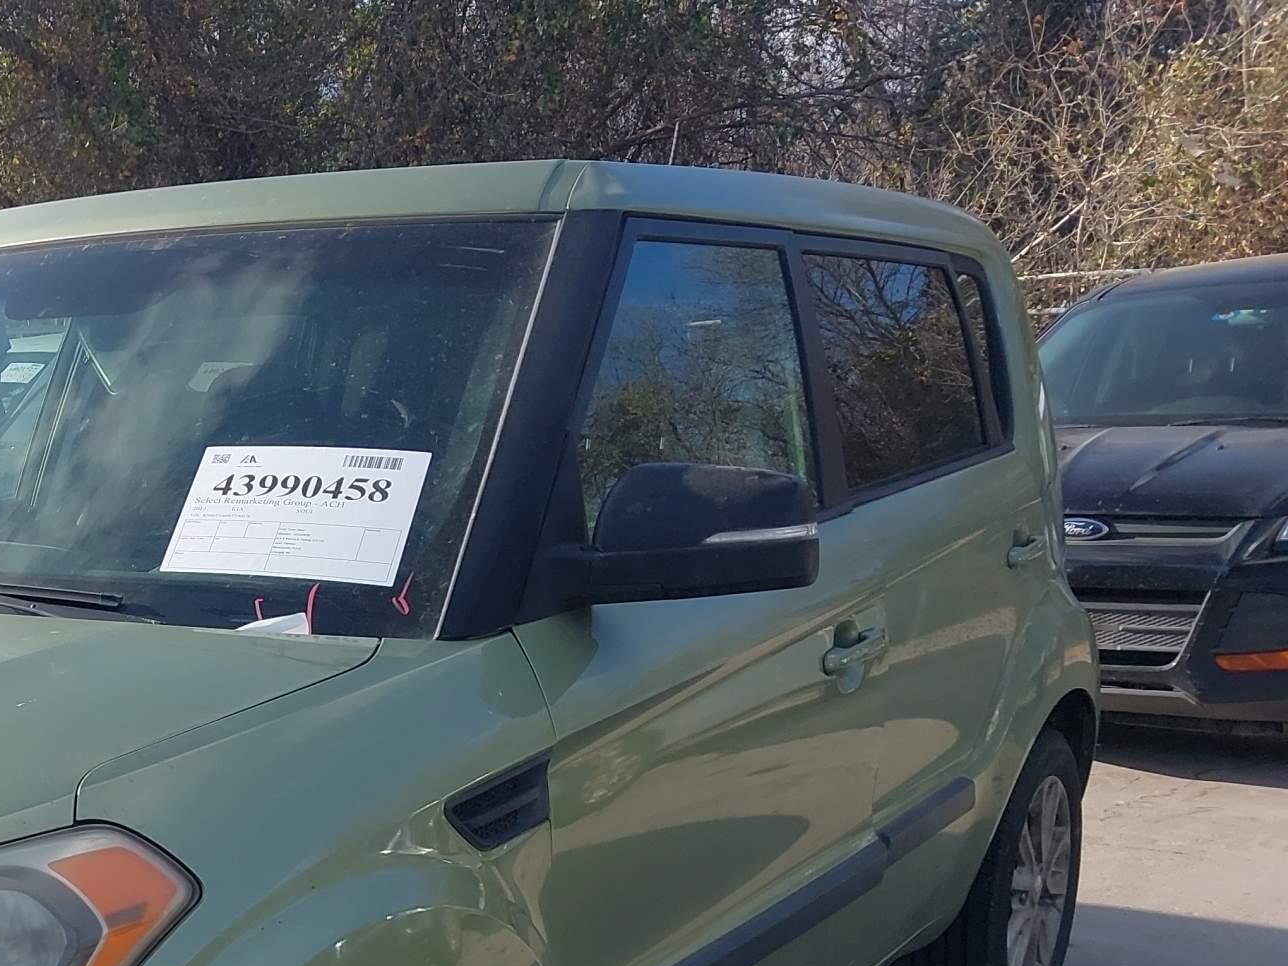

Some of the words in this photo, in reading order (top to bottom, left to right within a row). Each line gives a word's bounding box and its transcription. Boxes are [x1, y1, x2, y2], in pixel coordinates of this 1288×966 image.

[213, 473, 392, 502] 43990458
[194, 496, 222, 504] Select
[223, 497, 280, 507] Remarketing
[283, 499, 312, 508] Group
